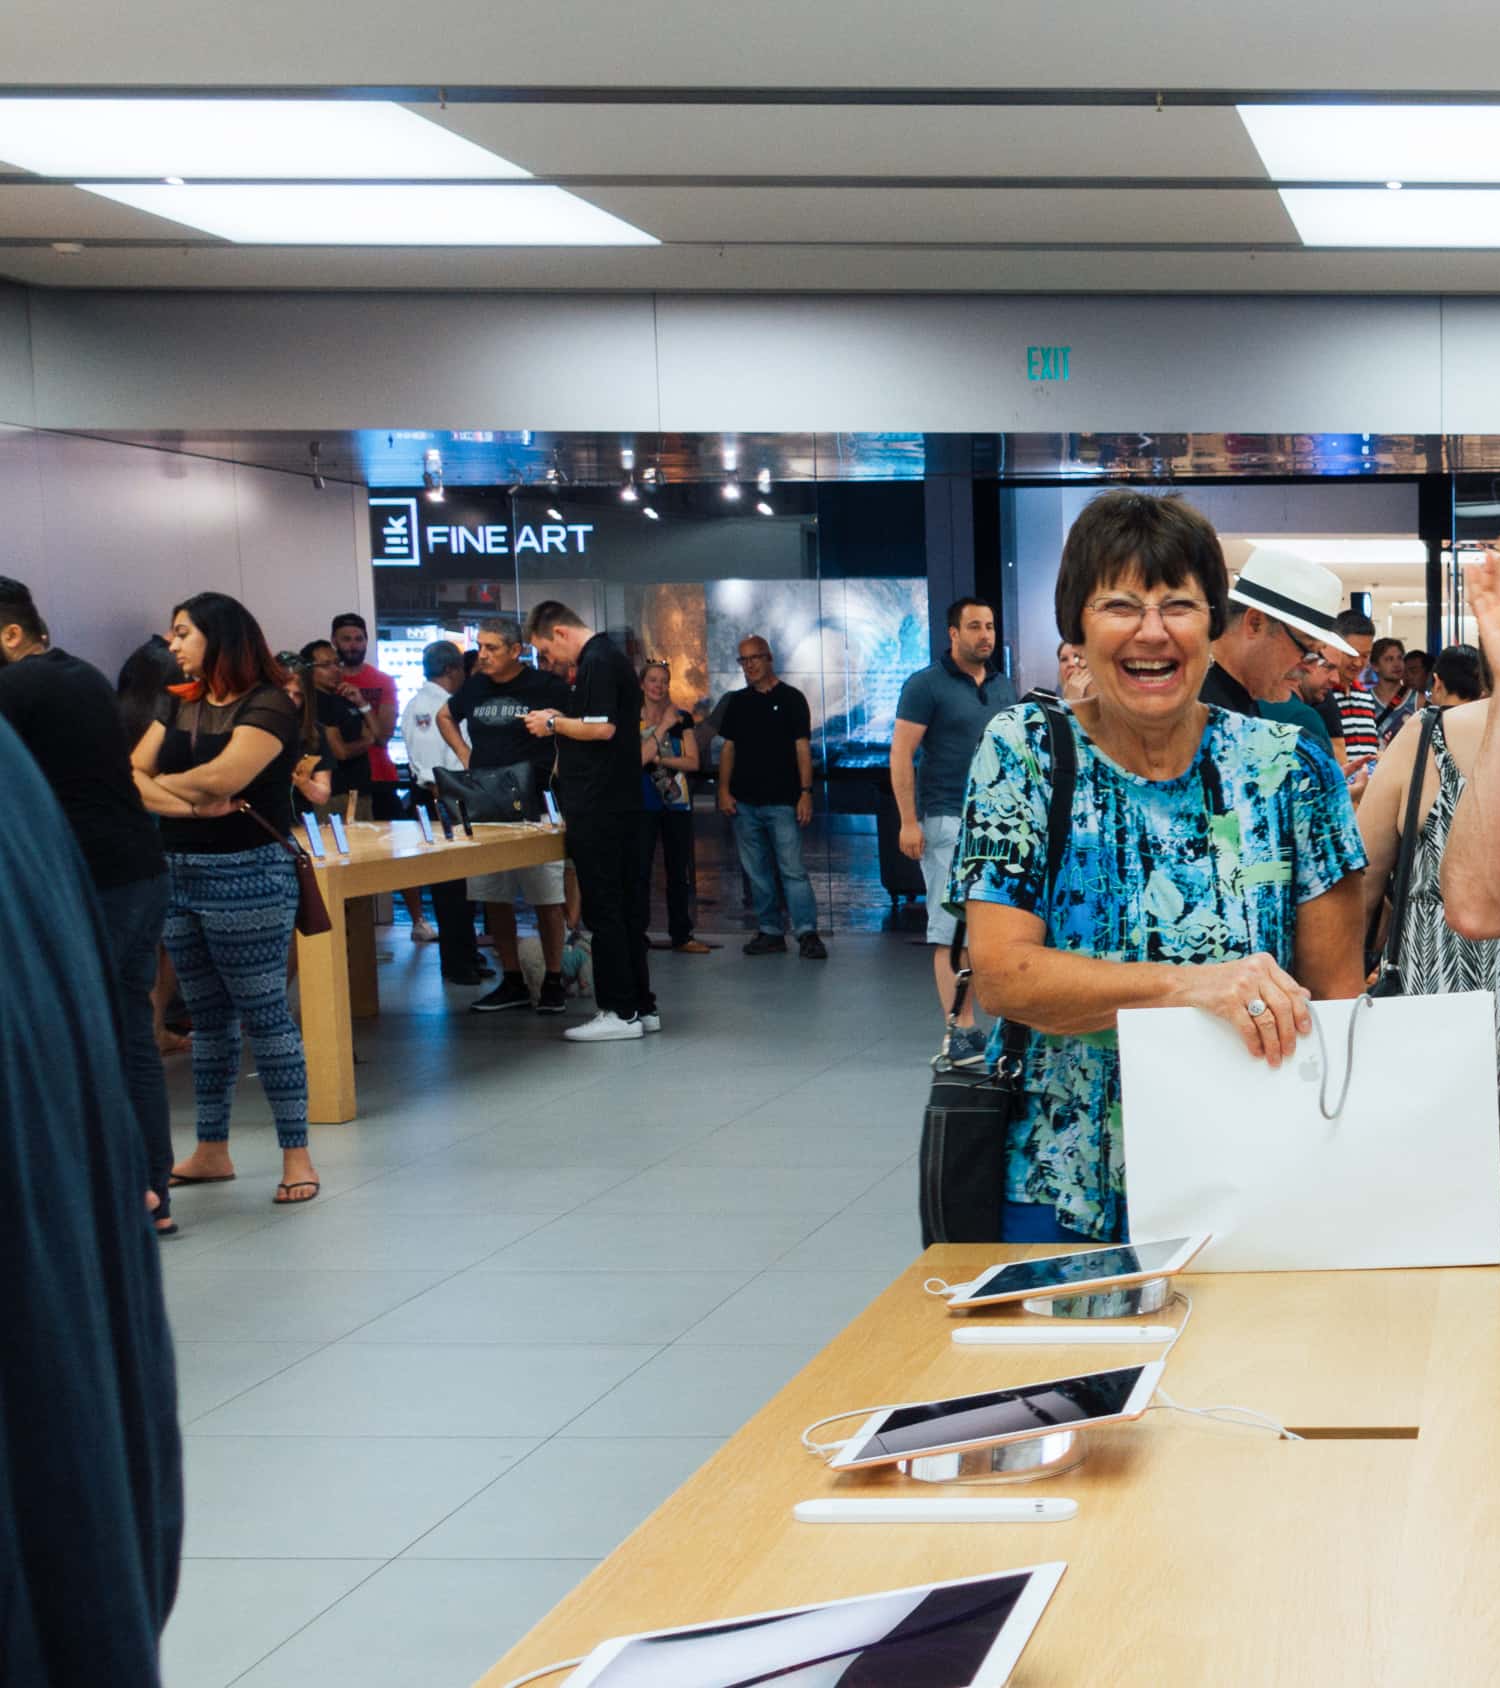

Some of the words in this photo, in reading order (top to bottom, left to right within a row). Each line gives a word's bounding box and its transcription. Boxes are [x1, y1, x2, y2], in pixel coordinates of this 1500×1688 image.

[1026, 345, 1072, 381] EXIT
[426, 524, 509, 554] FINE
[515, 524, 593, 554] ART
[473, 706, 498, 718] HUGO
[501, 705, 530, 717] BOSS
